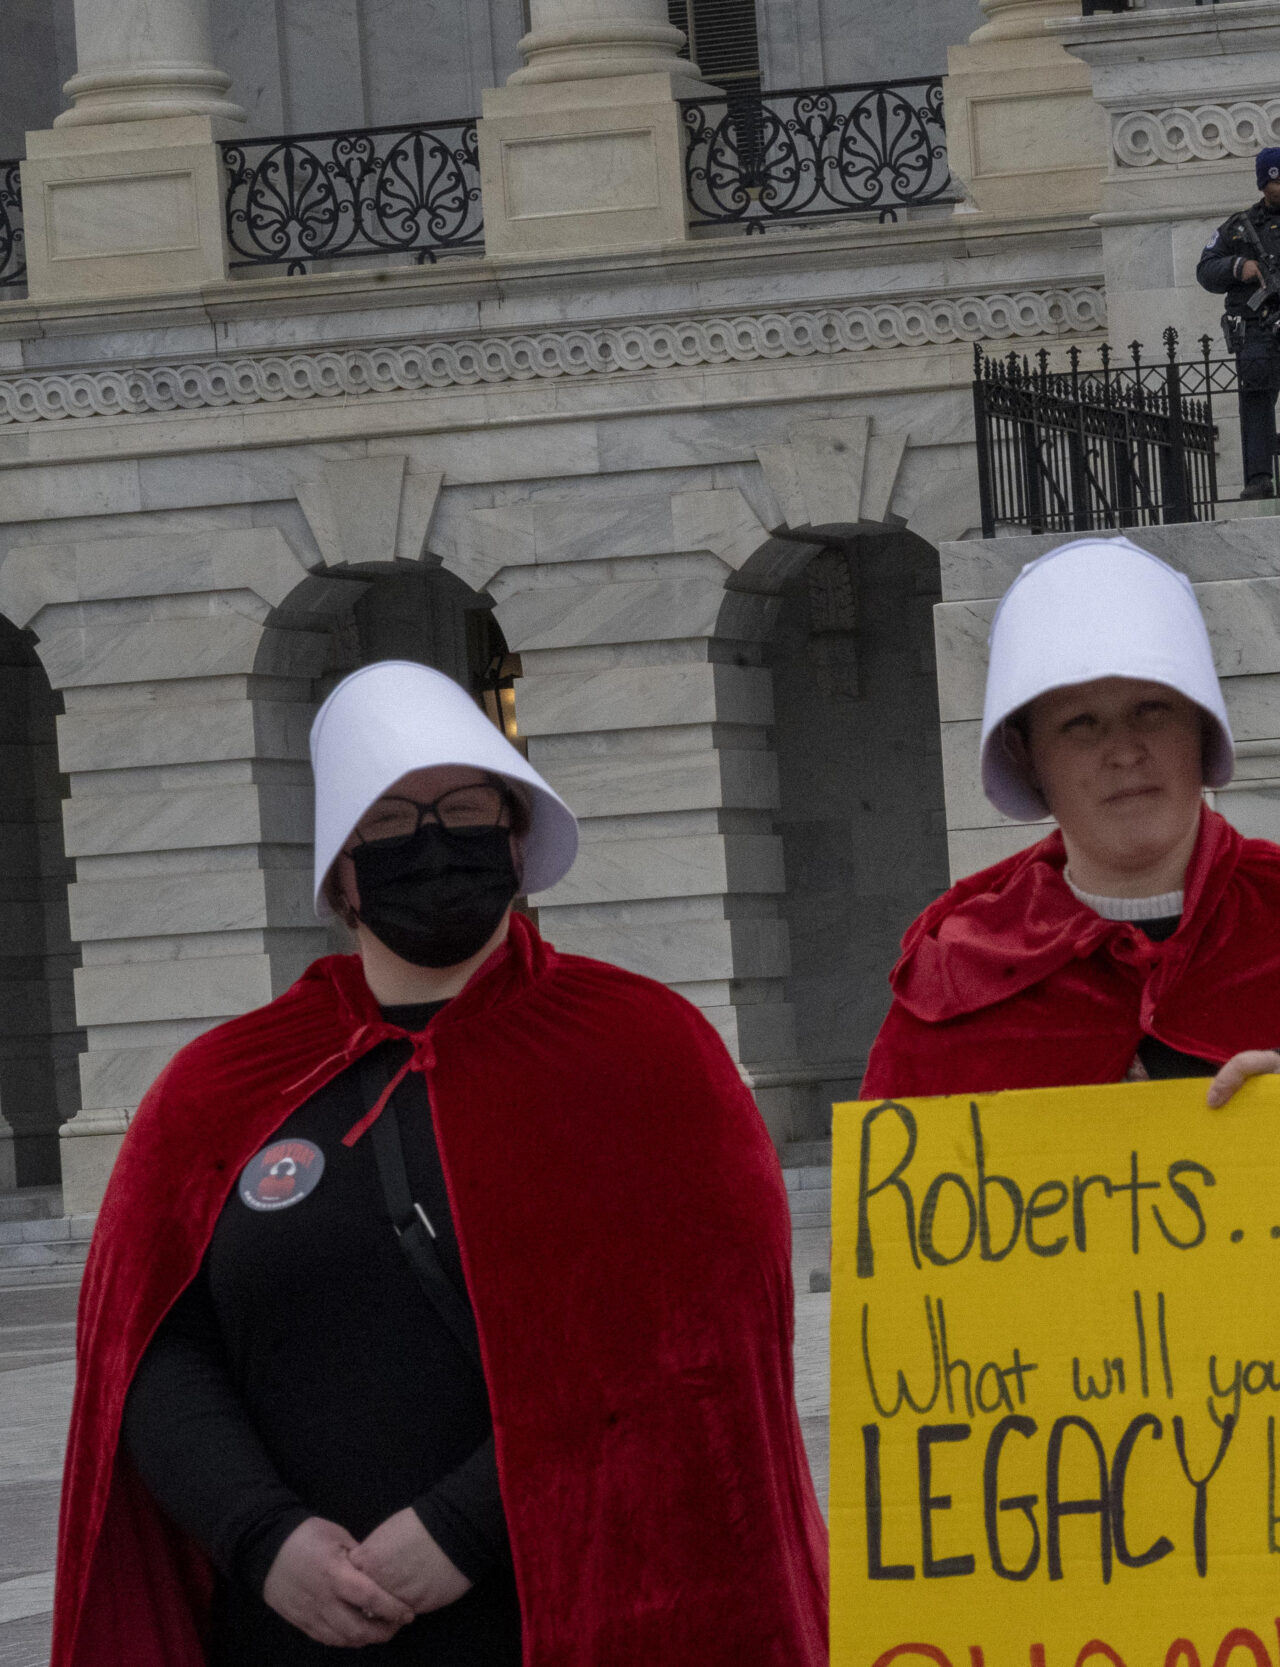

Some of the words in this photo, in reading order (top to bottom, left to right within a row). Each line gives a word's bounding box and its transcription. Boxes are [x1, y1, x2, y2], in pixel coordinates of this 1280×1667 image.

[861, 1294, 1039, 1419] What
[1072, 1290, 1174, 1401] will
[861, 1412, 1235, 1585] LEGACY
